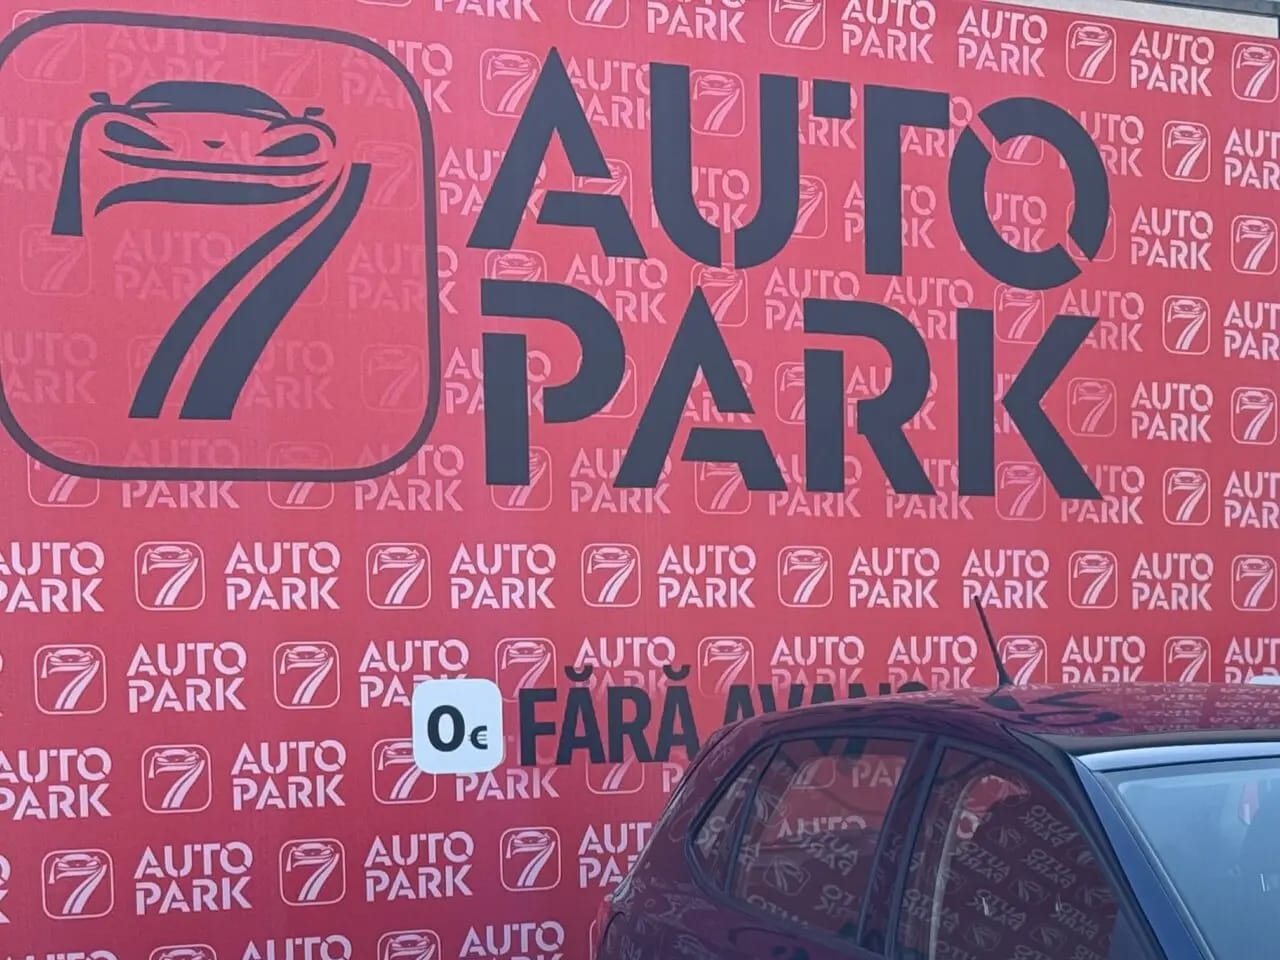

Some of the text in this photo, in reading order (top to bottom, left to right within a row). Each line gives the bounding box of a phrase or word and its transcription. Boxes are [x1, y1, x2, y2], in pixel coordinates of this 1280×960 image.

[647, 7, 746, 43] PARK
[842, 0, 935, 30] AUTO
[958, 11, 1048, 43] AUTO
[843, 24, 933, 63] PARK
[959, 38, 1044, 77] PARK
[1130, 29, 1214, 63] AUTO
[1131, 59, 1212, 96] PARK
[466, 46, 1110, 289] AUTO
[1131, 207, 1213, 240] AUTO
[1132, 237, 1211, 271] PARK
[565, 253, 668, 289] AUTO
[764, 266, 860, 300] AUTO
[883, 276, 974, 307] AUTO
[1059, 288, 1144, 320] AUTO
[481, 278, 1105, 500] PARK
[1132, 382, 1213, 412] AUTO
[1132, 412, 1211, 442] PARK
[122, 481, 239, 509] PARK
[354, 480, 463, 512] PARK
[570, 481, 671, 514] PARK
[769, 492, 861, 517] PARK
[886, 495, 974, 519] PARK
[1060, 495, 1144, 524] PARK
[225, 542, 340, 574] AUTO
[449, 544, 555, 574] AUTO
[658, 545, 756, 575] AUTO
[848, 547, 939, 576] AUTO
[962, 549, 1049, 578] AUTO
[1132, 553, 1213, 581] AUTO
[227, 577, 339, 610] PARK
[451, 577, 555, 609] PARK
[659, 577, 754, 608] PARK
[850, 579, 938, 608] PARK
[963, 580, 1048, 608] PARK
[1133, 582, 1211, 610] PARK
[127, 642, 246, 676] AUTO
[358, 639, 469, 673] AUTO
[573, 636, 676, 668] AUTO
[770, 636, 864, 666] AUTO
[888, 635, 977, 664] AUTO
[1062, 636, 1145, 663] AUTO
[129, 678, 245, 712] PARK
[518, 664, 700, 767] FĂRĂ
[0, 748, 111, 783] AUTO
[231, 740, 346, 775] AUTO
[233, 775, 345, 810] PARK
[456, 767, 559, 801] PARK
[134, 842, 252, 879] AUTO
[365, 831, 473, 867] AUTO
[136, 877, 251, 915] PARK
[366, 865, 472, 901] PARK
[460, 921, 564, 957] AUTO
